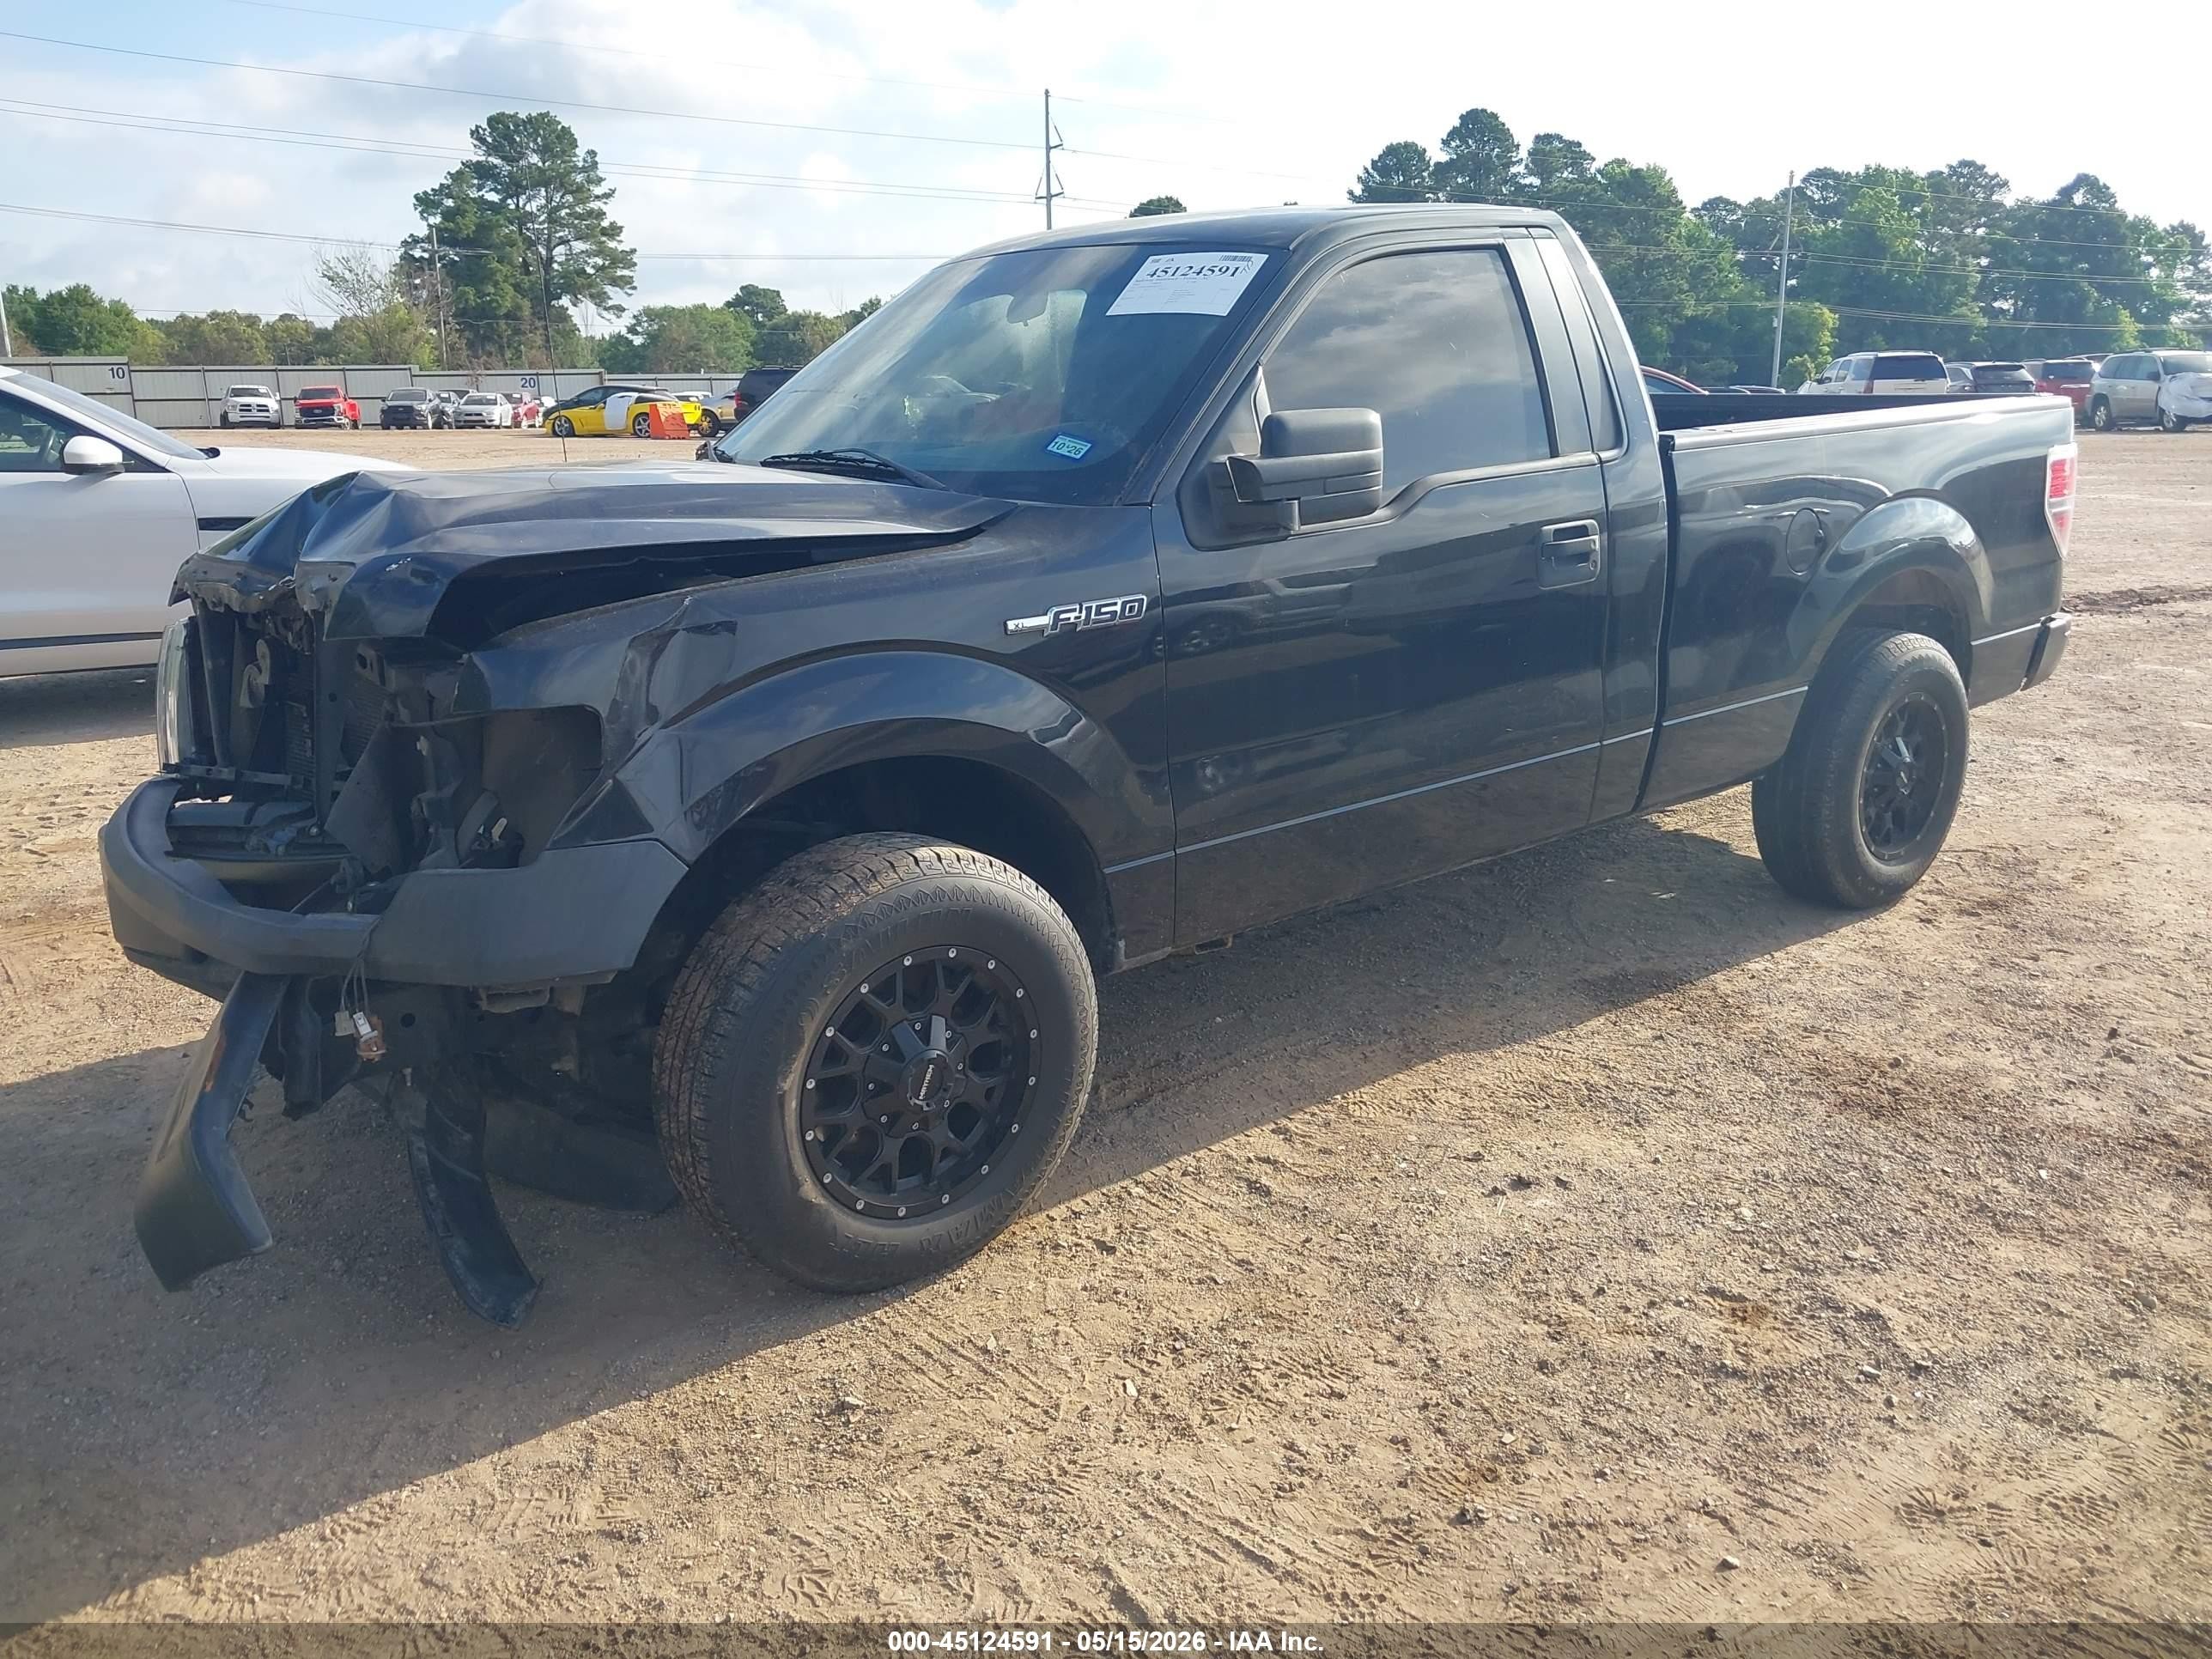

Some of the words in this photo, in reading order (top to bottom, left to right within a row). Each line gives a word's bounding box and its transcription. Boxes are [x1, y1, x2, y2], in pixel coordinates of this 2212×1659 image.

[1146, 264, 1241, 277] 45124591
[108, 367, 125, 380] 10
[520, 377, 536, 388] 20
[1051, 441, 1066, 451] 10
[1012, 622, 1029, 630] XL
[1043, 594, 1148, 636] F-150
